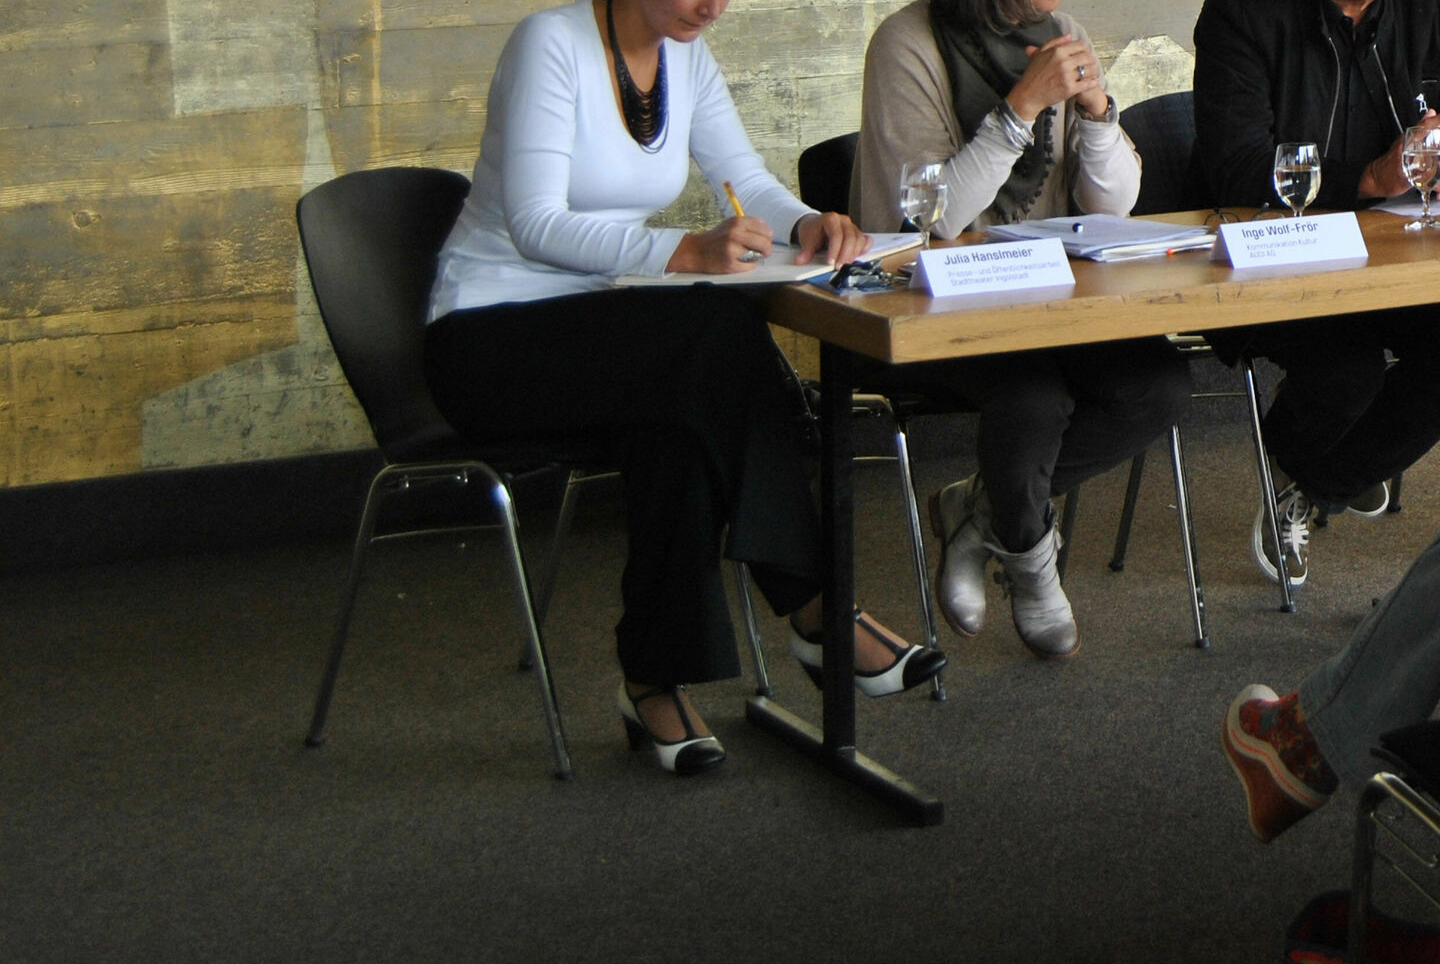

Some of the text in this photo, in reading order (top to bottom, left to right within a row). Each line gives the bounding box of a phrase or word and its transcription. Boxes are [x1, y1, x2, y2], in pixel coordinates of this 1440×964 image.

[1242, 222, 1318, 240] Inge Wolf-Frör
[944, 247, 1033, 266] Julia Hanslmeier
